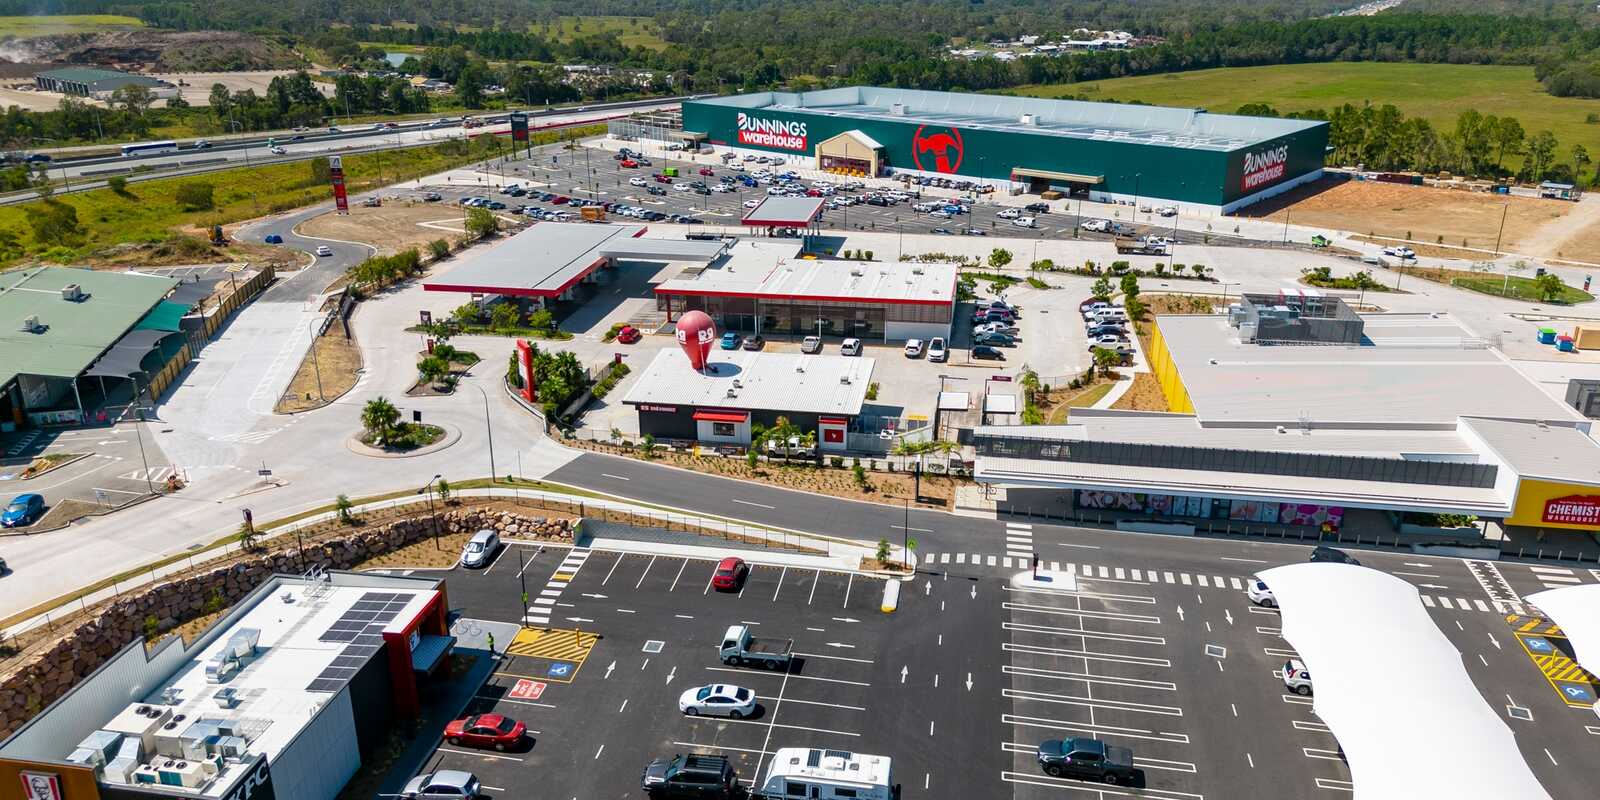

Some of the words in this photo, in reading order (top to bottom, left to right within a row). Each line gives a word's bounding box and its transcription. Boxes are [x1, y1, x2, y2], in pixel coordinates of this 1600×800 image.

[737, 112, 807, 137] BUNNINGS
[742, 130, 804, 149] warehouse
[1244, 145, 1288, 175] BUNNINGS
[1547, 514, 1598, 523] WAREHOUSE
[1548, 503, 1600, 517] CHEMIST
